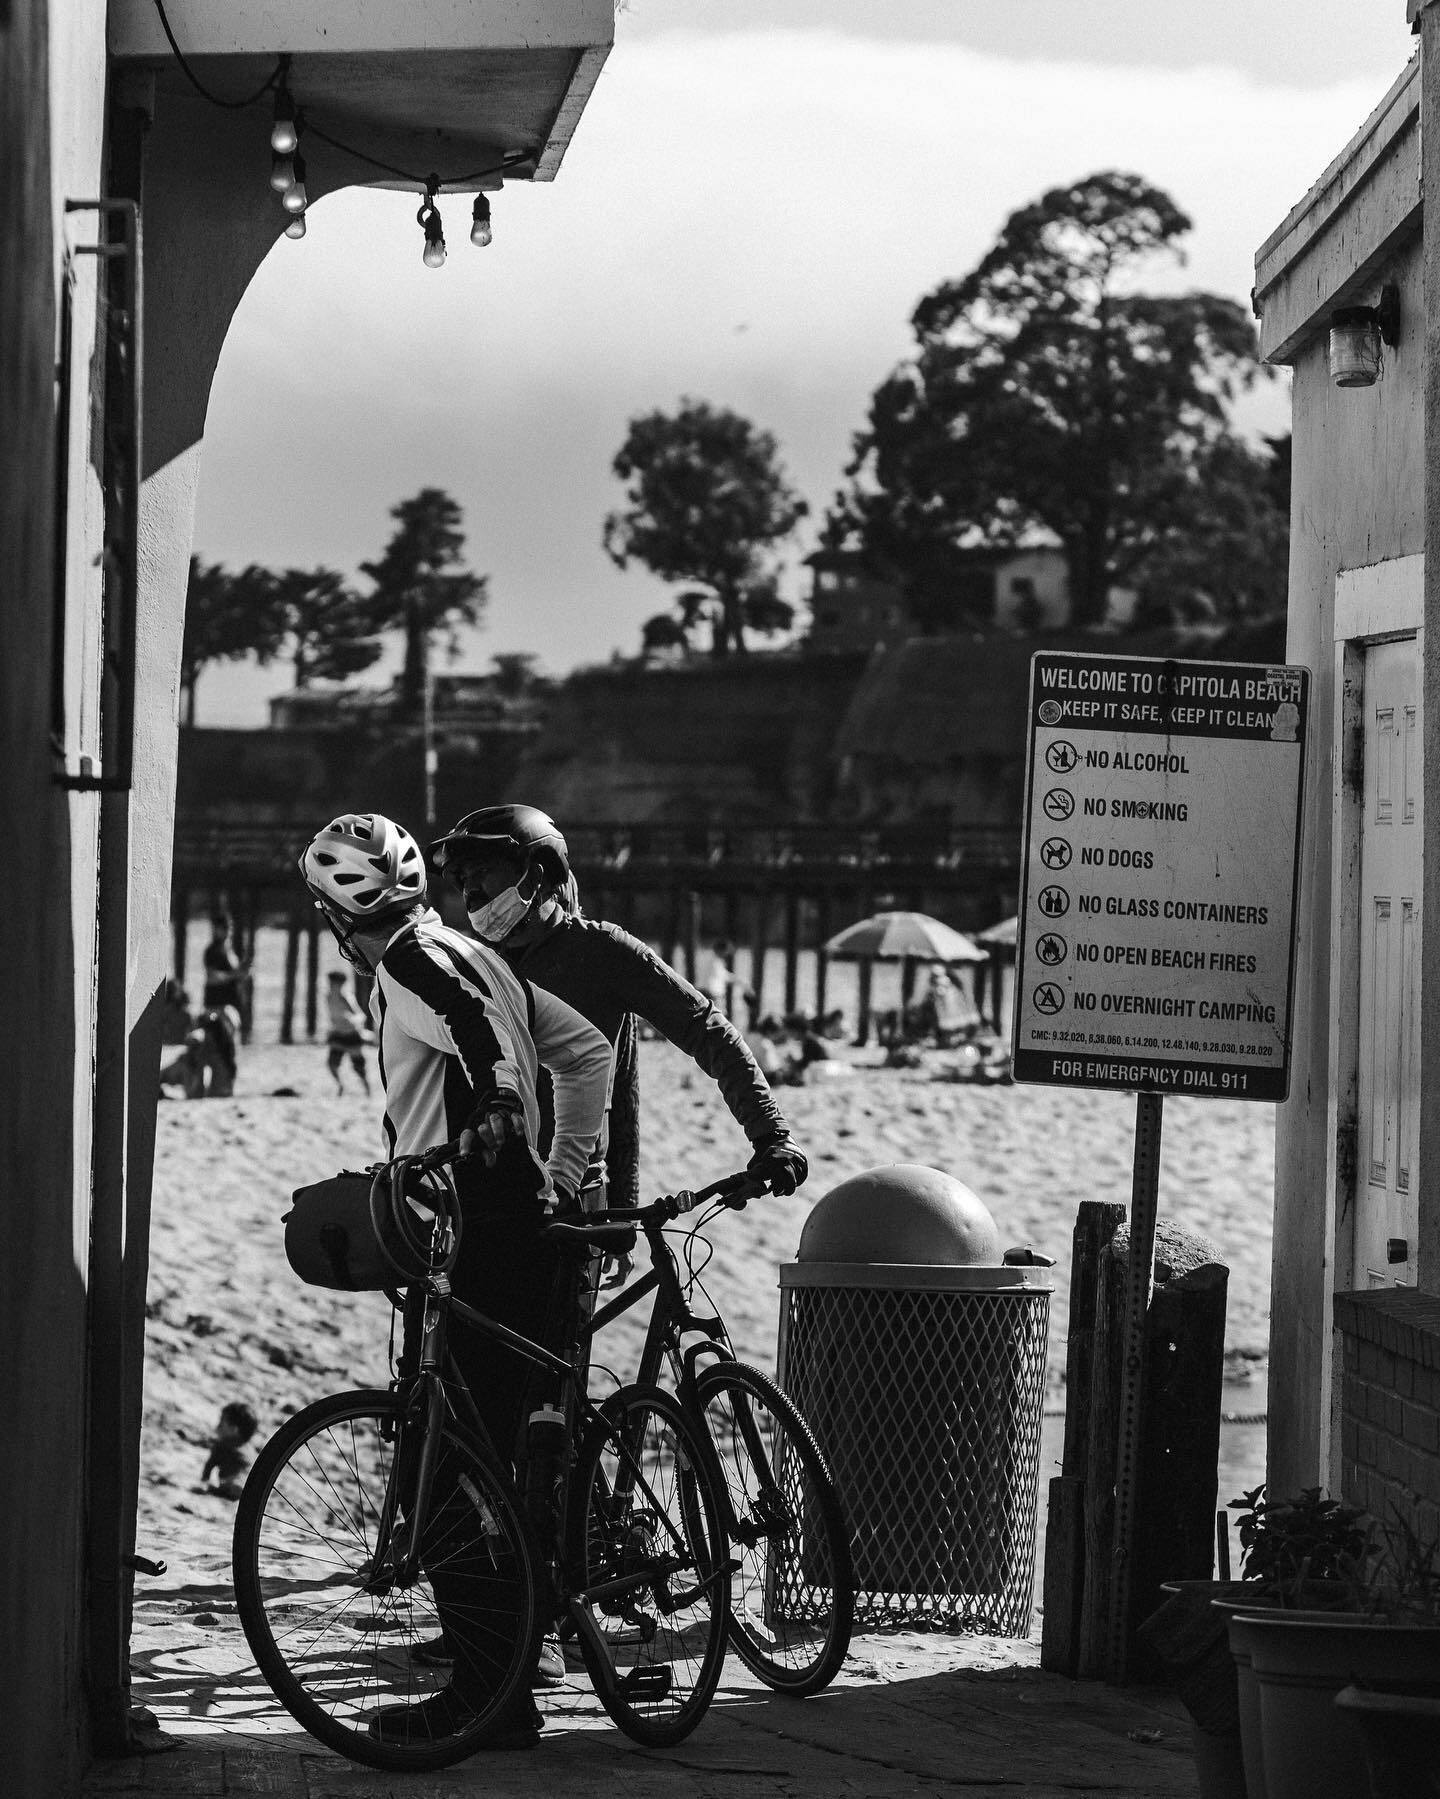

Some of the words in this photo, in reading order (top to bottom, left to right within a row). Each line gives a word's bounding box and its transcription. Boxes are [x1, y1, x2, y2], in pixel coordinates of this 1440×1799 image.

[1041, 668, 1127, 691] WELCOME
[1133, 674, 1152, 694] TO
[1245, 680, 1301, 702] BEACH
[1063, 701, 1100, 718] KEEP
[1104, 703, 1118, 719] IT
[1121, 704, 1162, 724] SAFE,
[1209, 710, 1223, 725] IT
[1086, 750, 1109, 768] NO
[1113, 752, 1189, 773] ALCOHOL
[1084, 799, 1106, 816] NO
[1111, 800, 1187, 821] SMKING
[1081, 848, 1104, 865] NO
[1109, 850, 1153, 869] DOGS
[1079, 895, 1101, 913] NO
[1106, 897, 1159, 918] GLASS
[1164, 901, 1268, 925] CONTAINERS
[1076, 944, 1098, 962] NO
[1103, 945, 1146, 965] OPEN
[1151, 948, 1205, 969] BEACH
[1210, 953, 1256, 973] FIRES
[1074, 992, 1096, 1010] NO
[1101, 994, 1195, 1018] OVERNIGHT
[1200, 1001, 1275, 1024] CAMPING
[1031, 1030, 1051, 1041] CMC:
[1053, 1061, 1082, 1078] FOR
[1183, 1070, 1217, 1088] DIAL
[1221, 1072, 1248, 1090] 911
